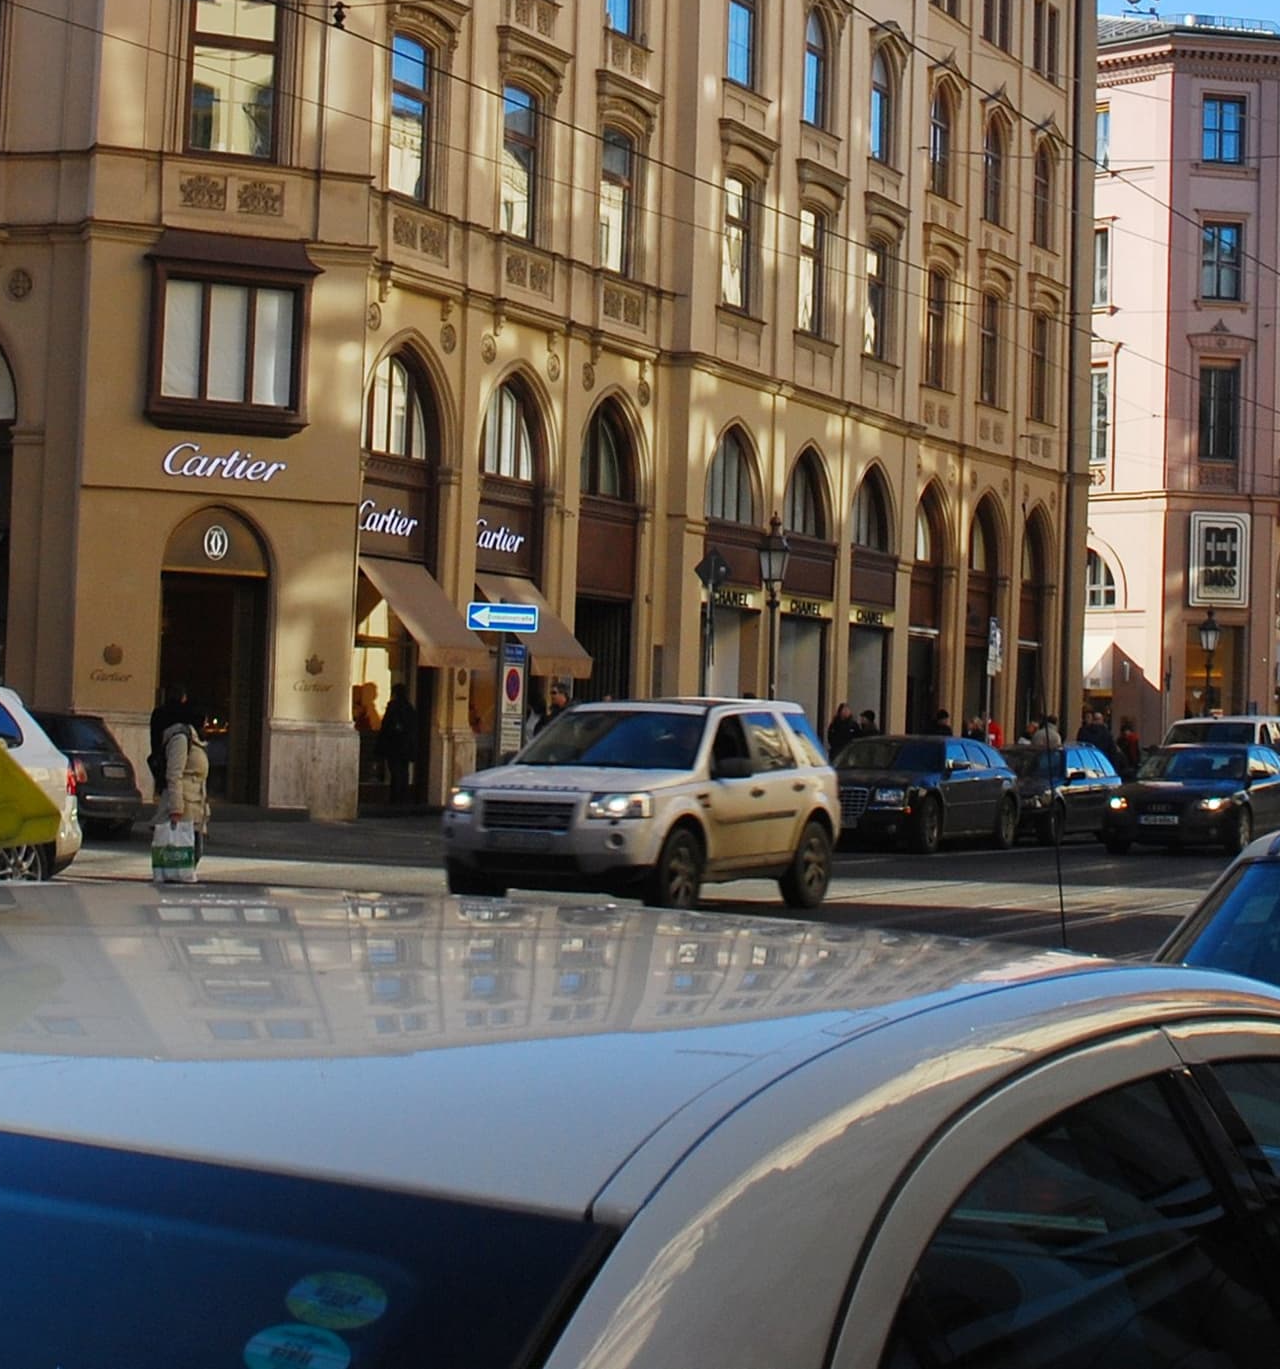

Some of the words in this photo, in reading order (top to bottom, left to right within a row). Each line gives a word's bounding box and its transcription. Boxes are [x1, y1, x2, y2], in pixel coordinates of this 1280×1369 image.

[163, 442, 287, 482] Cartier
[359, 499, 418, 537] Cartier
[790, 598, 822, 617] CHANEL
[856, 608, 884, 625] CHANEL
